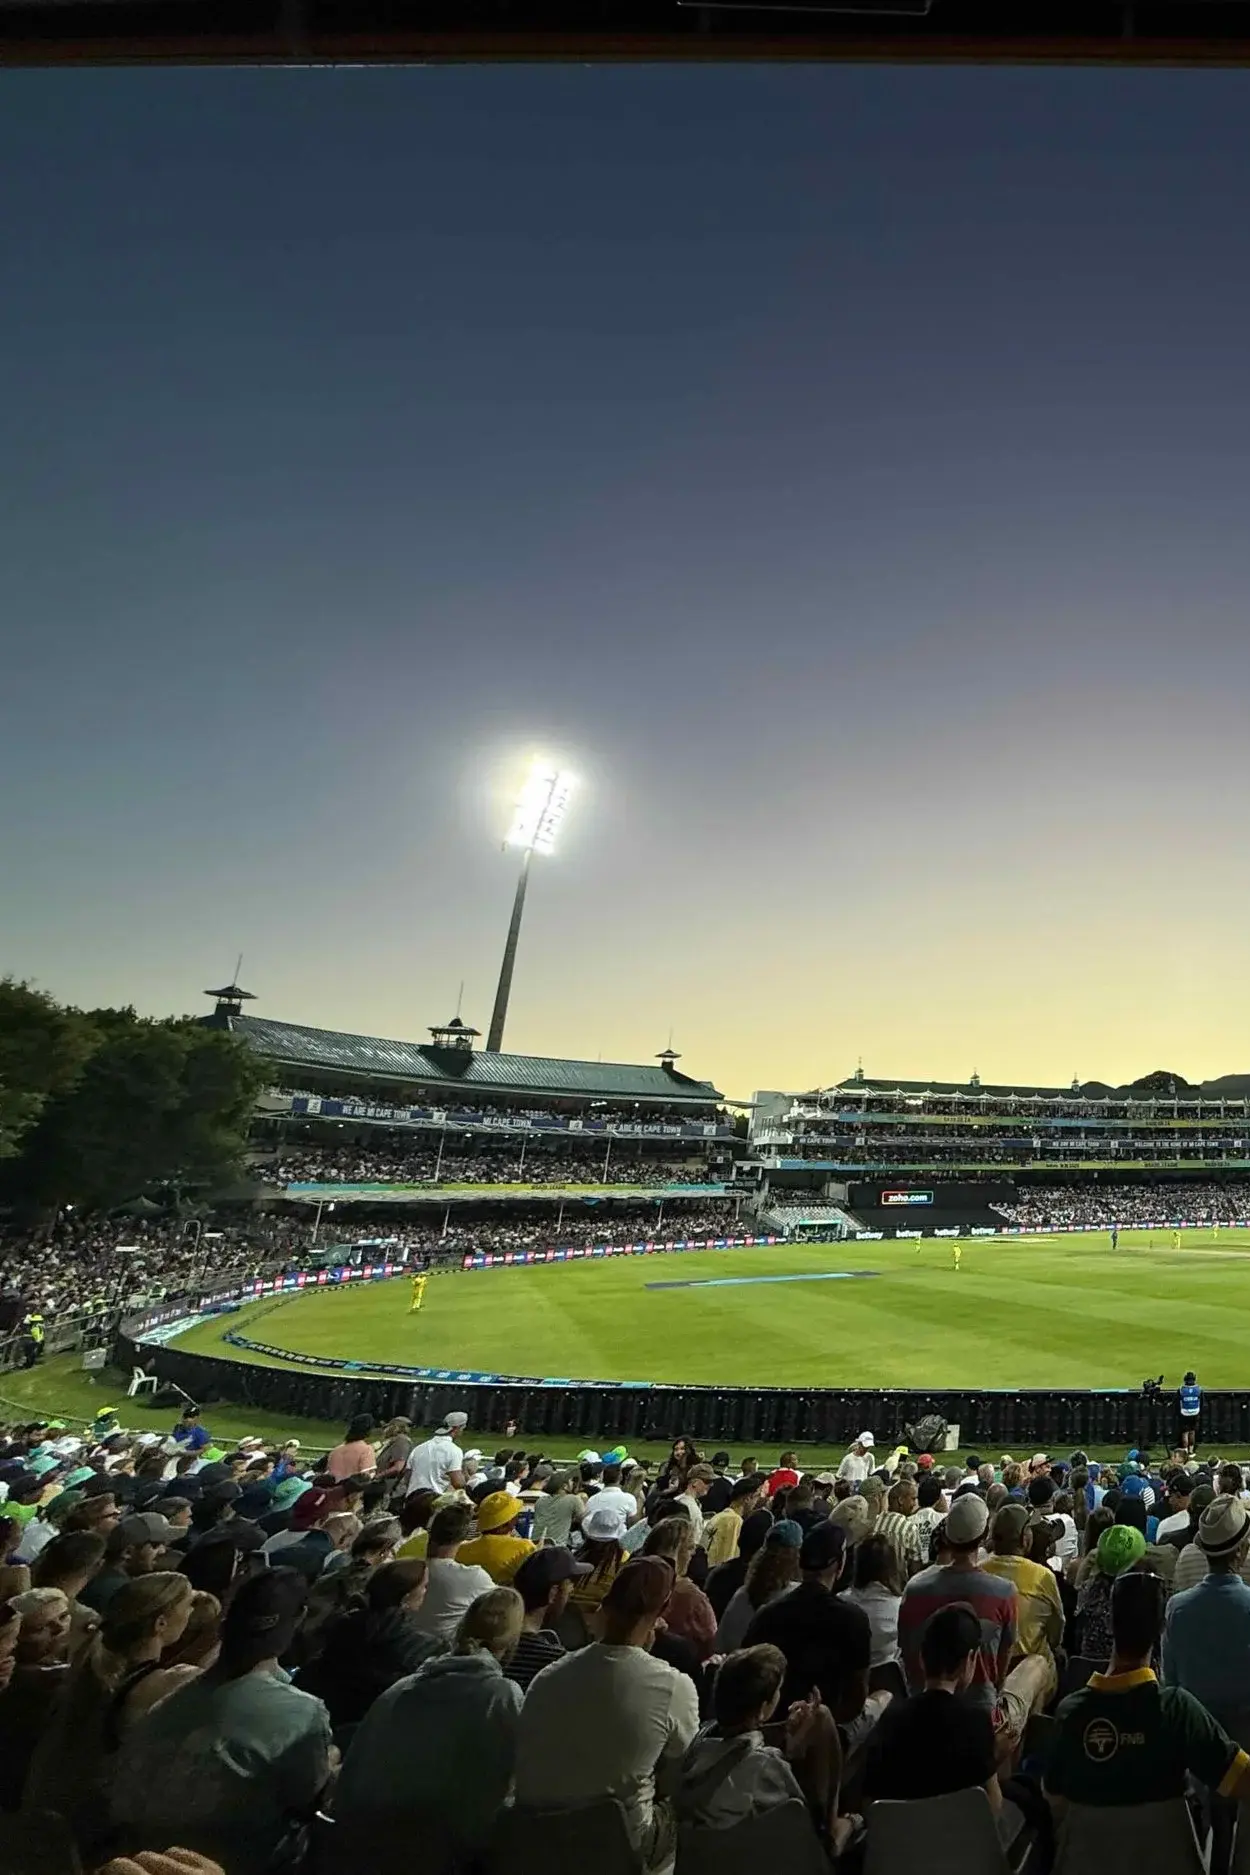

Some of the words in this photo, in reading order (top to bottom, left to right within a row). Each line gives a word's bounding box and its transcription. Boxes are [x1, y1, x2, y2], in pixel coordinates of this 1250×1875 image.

[342, 1105, 353, 1115] WE
[353, 1105, 366, 1116] ARE
[376, 1108, 393, 1118] CAPE
[393, 1109, 411, 1120] TOWN
[493, 1117, 511, 1127] CAPE
[513, 1118, 532, 1128] TOWN
[619, 1124, 632, 1132] ARE
[644, 1125, 661, 1133] CAPE
[888, 1193, 928, 1202] zoho.com
[856, 1231, 884, 1240] betway
[895, 1229, 923, 1238] betway
[934, 1228, 960, 1236] betway
[971, 1227, 996, 1236] betway
[1120, 1732, 1145, 1745] FNB
